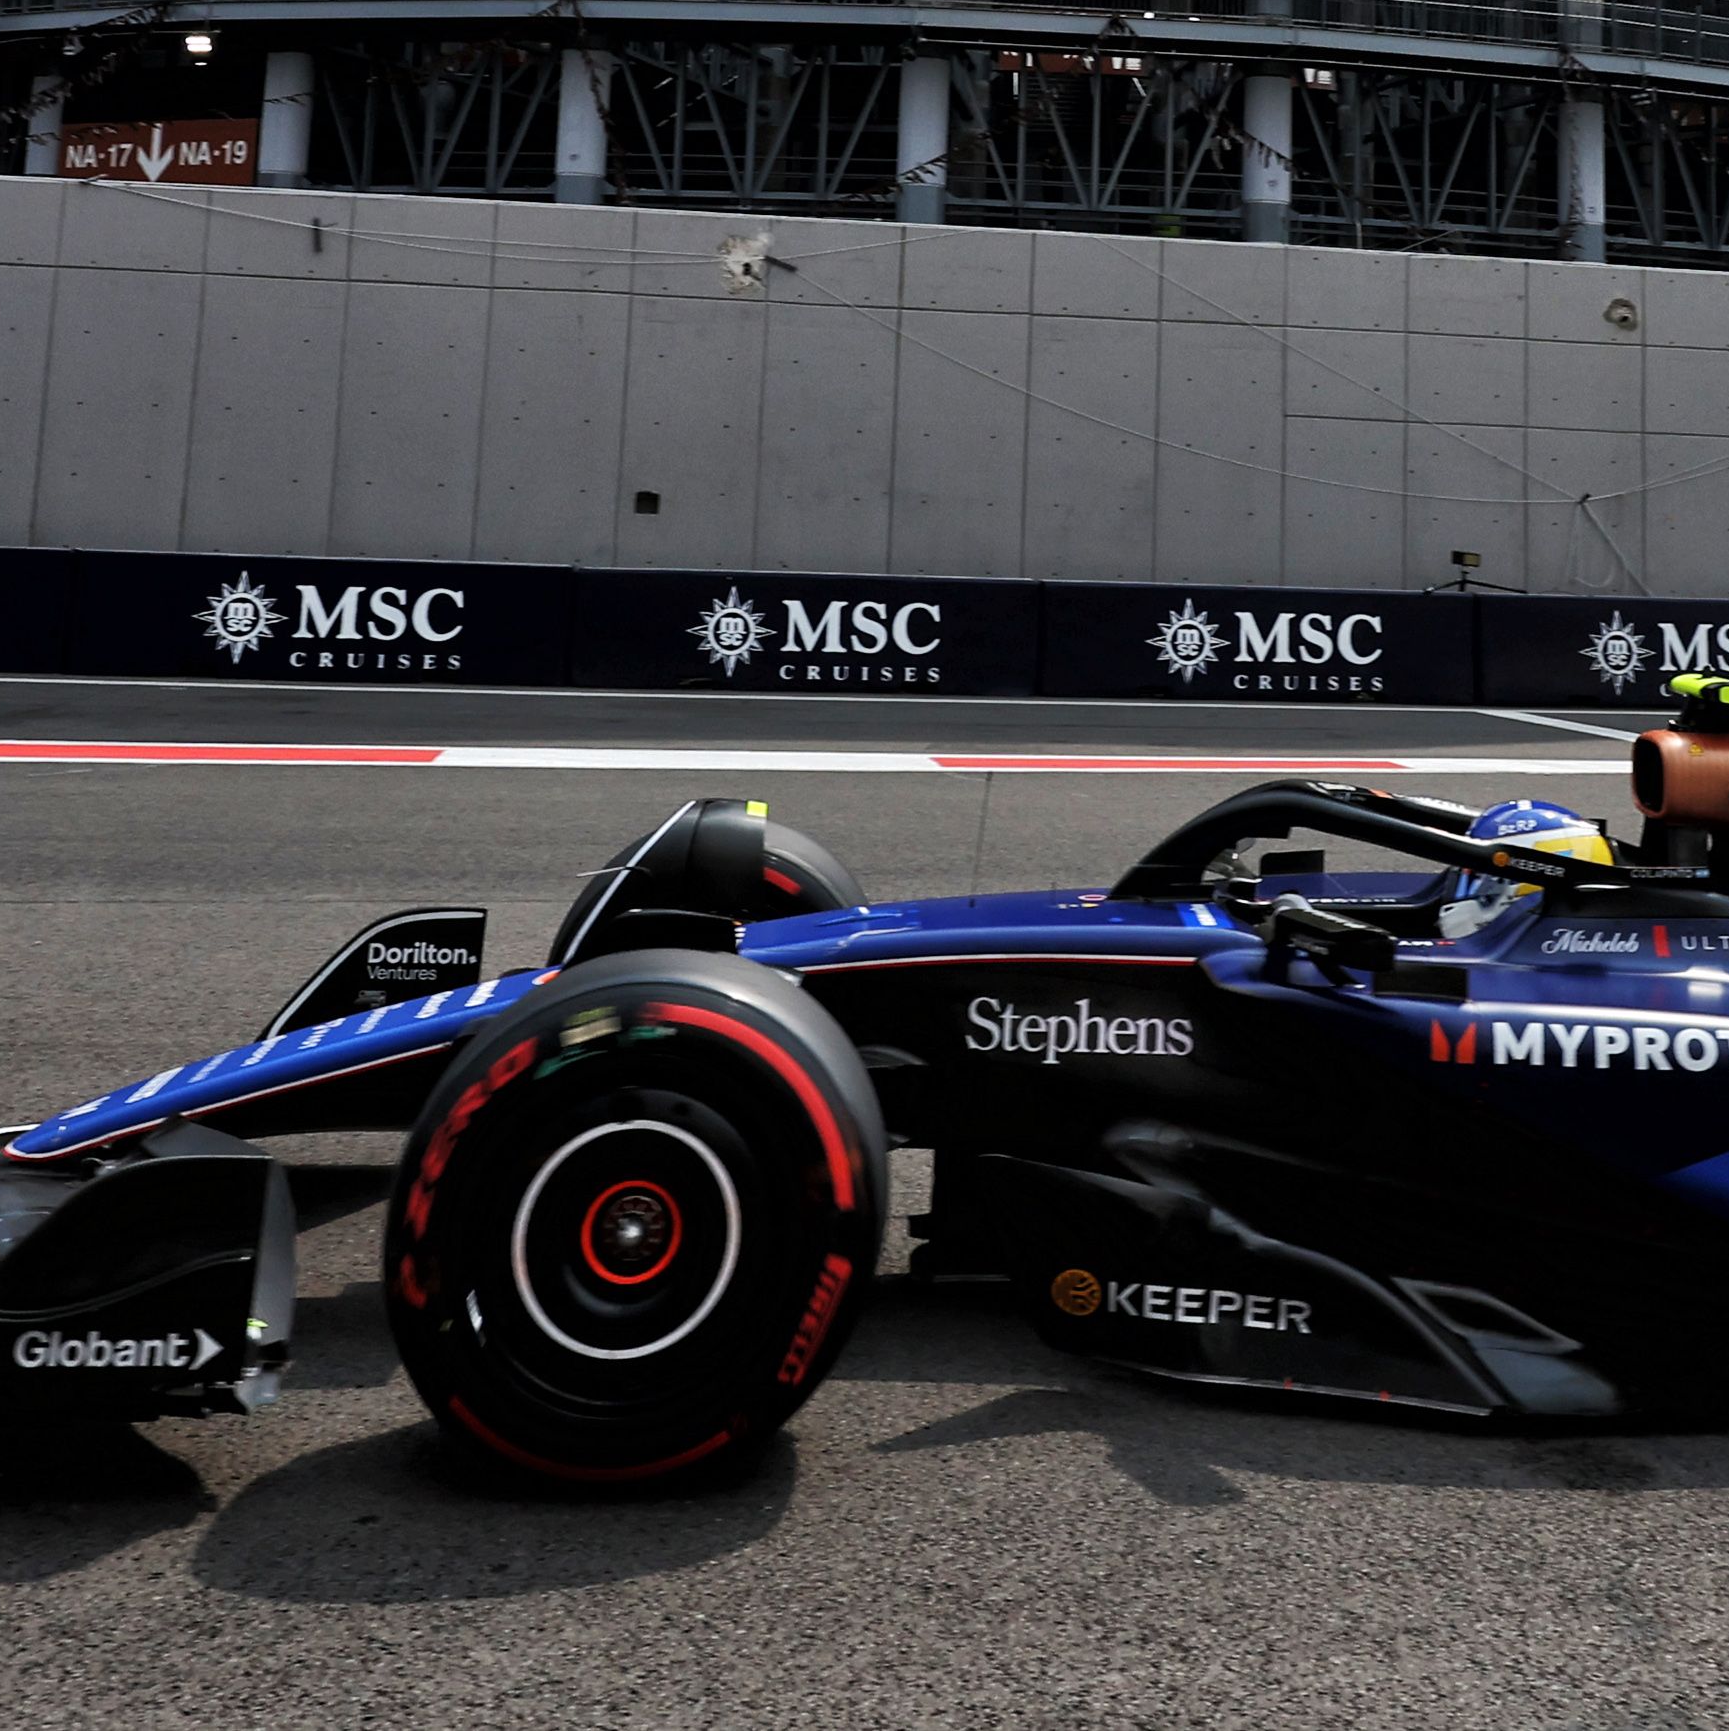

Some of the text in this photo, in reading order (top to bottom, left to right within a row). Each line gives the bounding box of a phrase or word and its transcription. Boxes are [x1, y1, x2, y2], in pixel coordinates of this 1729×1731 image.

[65, 140, 247, 168] NA-17 NA-19
[294, 584, 464, 642] MSC
[780, 599, 941, 655] MSC
[1233, 611, 1382, 665] MSC
[289, 651, 461, 670] CRUISES
[779, 664, 940, 683] CRUISES
[1233, 674, 1383, 692] CRUISES
[1510, 857, 1566, 877] KEEPER
[367, 941, 468, 964] Dorilton
[1541, 928, 1640, 954] Michelob
[368, 965, 438, 981] Ventures
[965, 996, 1193, 1065] Stephens
[1109, 1281, 1311, 1334] KEEPER
[13, 1330, 190, 1369] Globant
